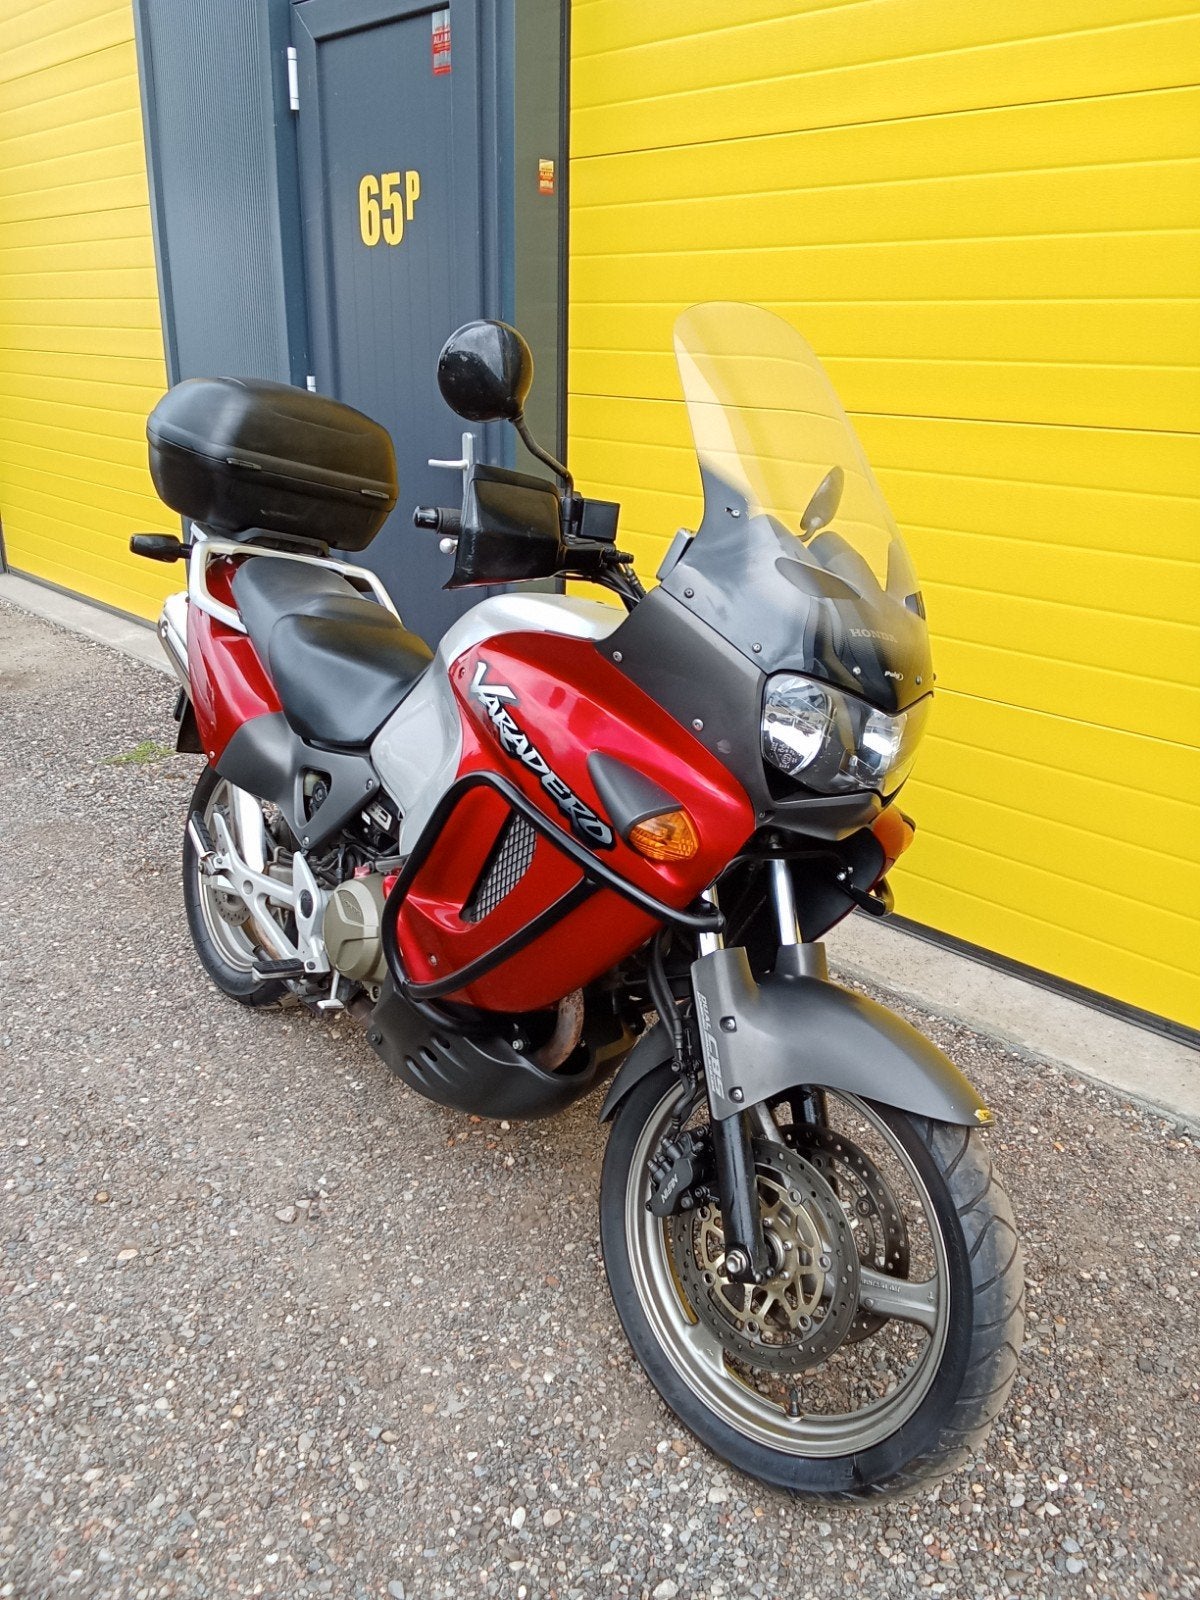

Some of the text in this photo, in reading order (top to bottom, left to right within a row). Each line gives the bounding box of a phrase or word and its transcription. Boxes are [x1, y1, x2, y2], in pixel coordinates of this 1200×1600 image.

[359, 170, 421, 246] 65P
[849, 628, 898, 643] HONDA
[469, 660, 614, 846] VARADERO
[706, 1033, 725, 1100] CBS
